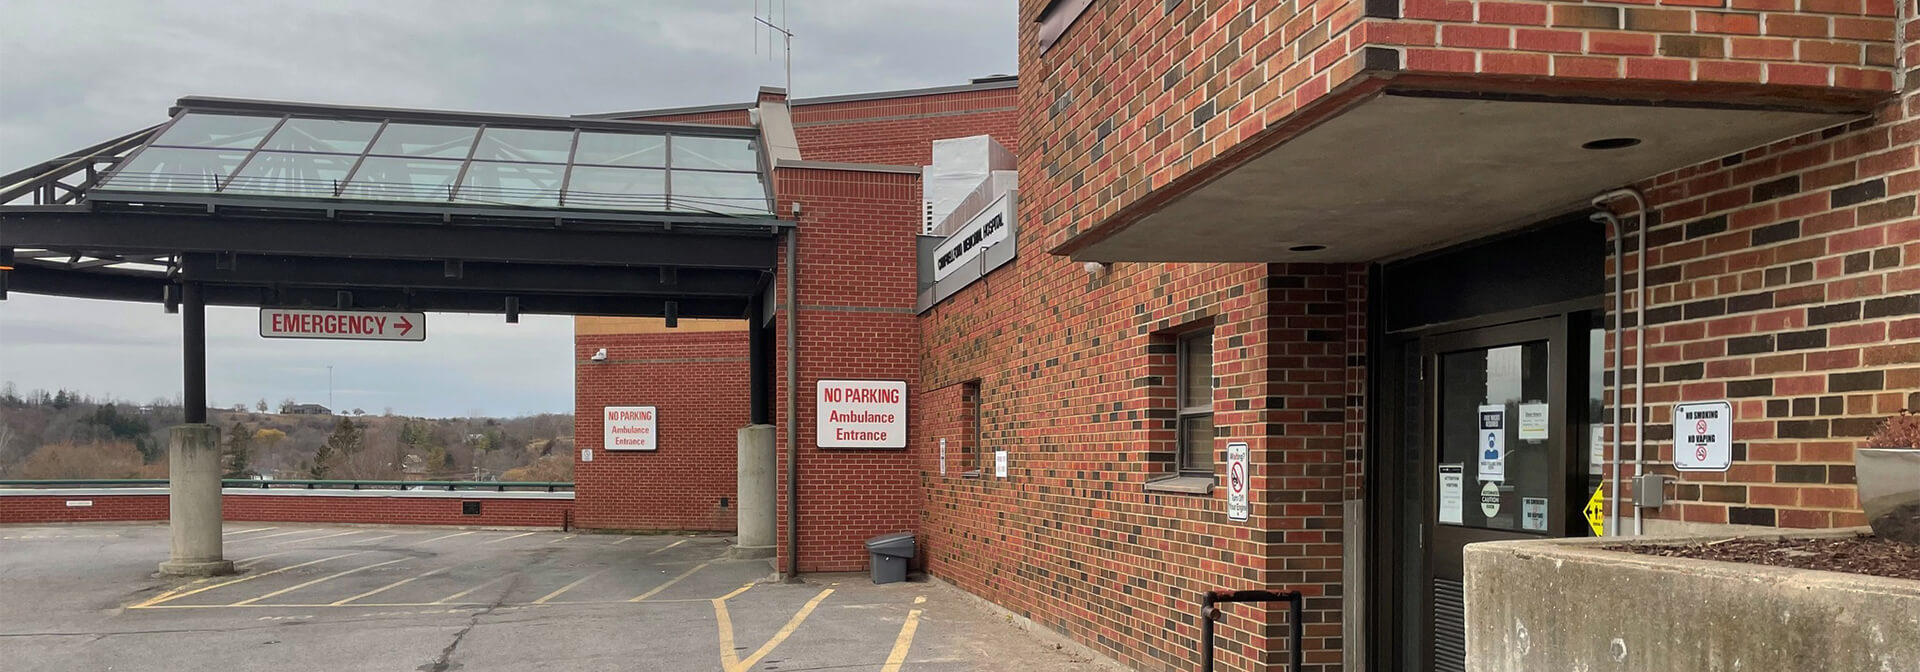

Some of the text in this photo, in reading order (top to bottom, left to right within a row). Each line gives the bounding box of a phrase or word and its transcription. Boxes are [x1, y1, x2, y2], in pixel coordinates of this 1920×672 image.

[272, 313, 387, 335] EMERGENCY
[824, 387, 900, 404] NO PARKING
[608, 411, 652, 421] NO PARKING
[829, 409, 895, 424] Ambulance
[1686, 410, 1718, 420] NO SMOKING
[612, 425, 650, 434] Ambulance
[836, 427, 888, 441] Entrance
[615, 436, 646, 446] Entrance
[1688, 435, 1715, 443] NO VAPING
